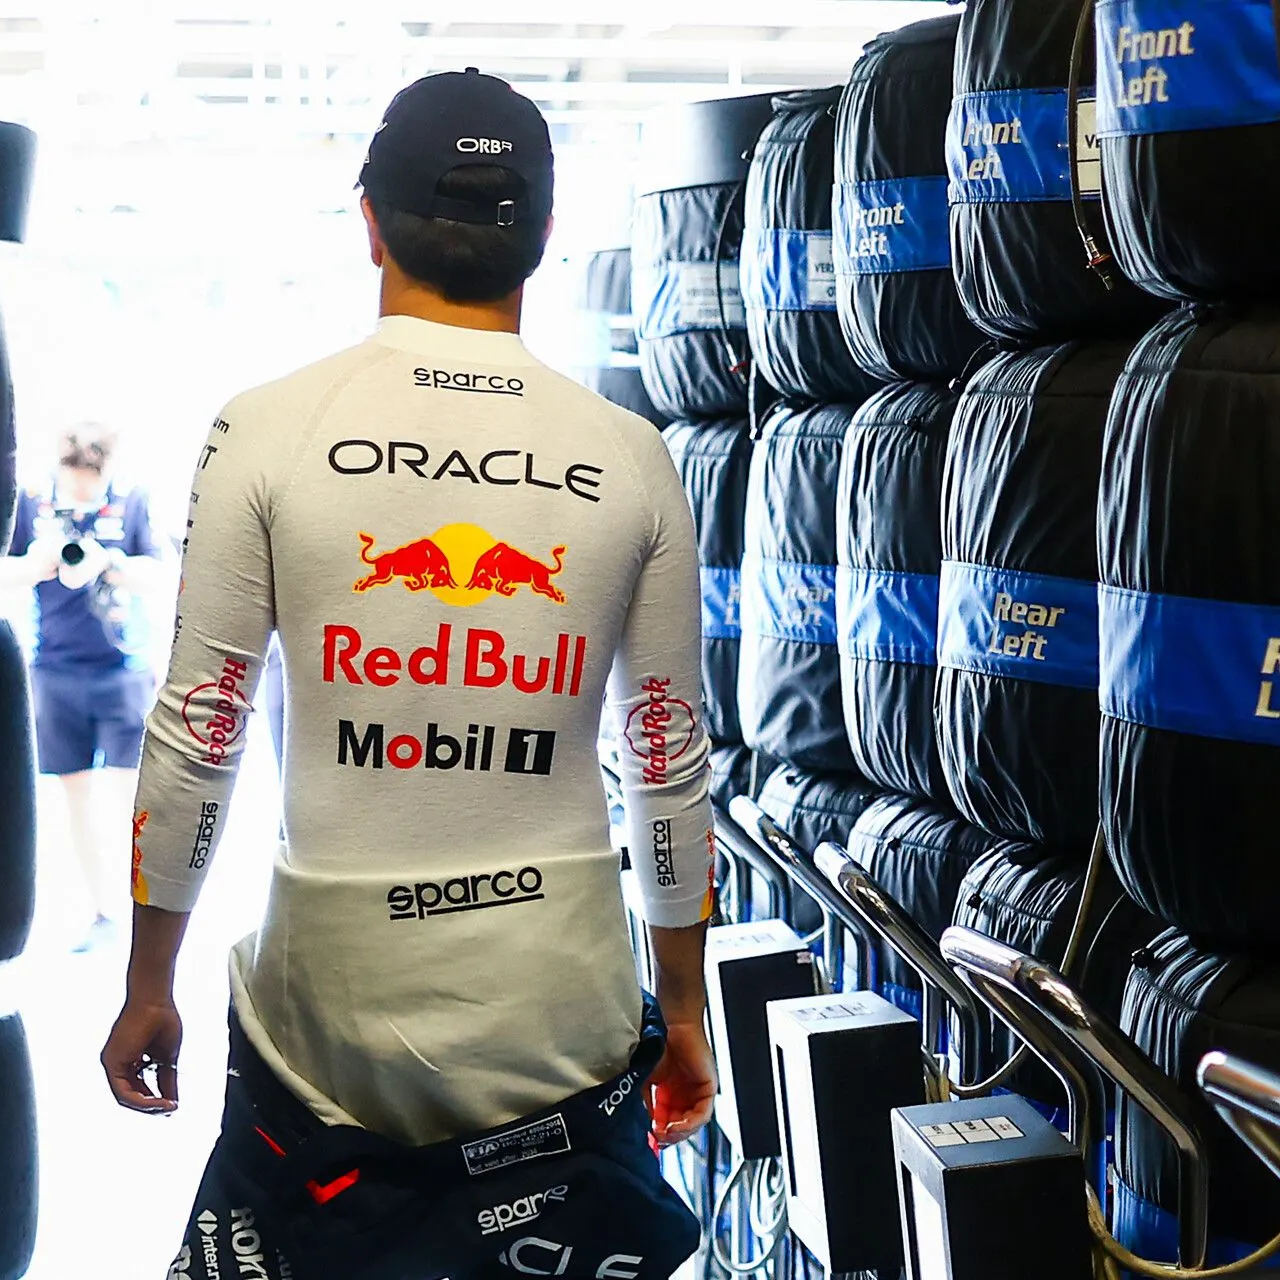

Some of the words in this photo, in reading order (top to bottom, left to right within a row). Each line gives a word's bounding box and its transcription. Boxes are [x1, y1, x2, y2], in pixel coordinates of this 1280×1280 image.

[1117, 21, 1195, 64] Front
[414, 367, 524, 396] sparco
[328, 439, 605, 503] ORACLE
[993, 592, 1066, 627] Rear
[322, 623, 453, 688] Red
[463, 628, 587, 697] Bull
[989, 630, 1048, 661] Left
[337, 719, 496, 772] Mobil
[189, 802, 219, 869] sparco
[653, 819, 677, 888] sparco
[387, 866, 545, 920] sparco
[598, 1071, 639, 1116] zoo
